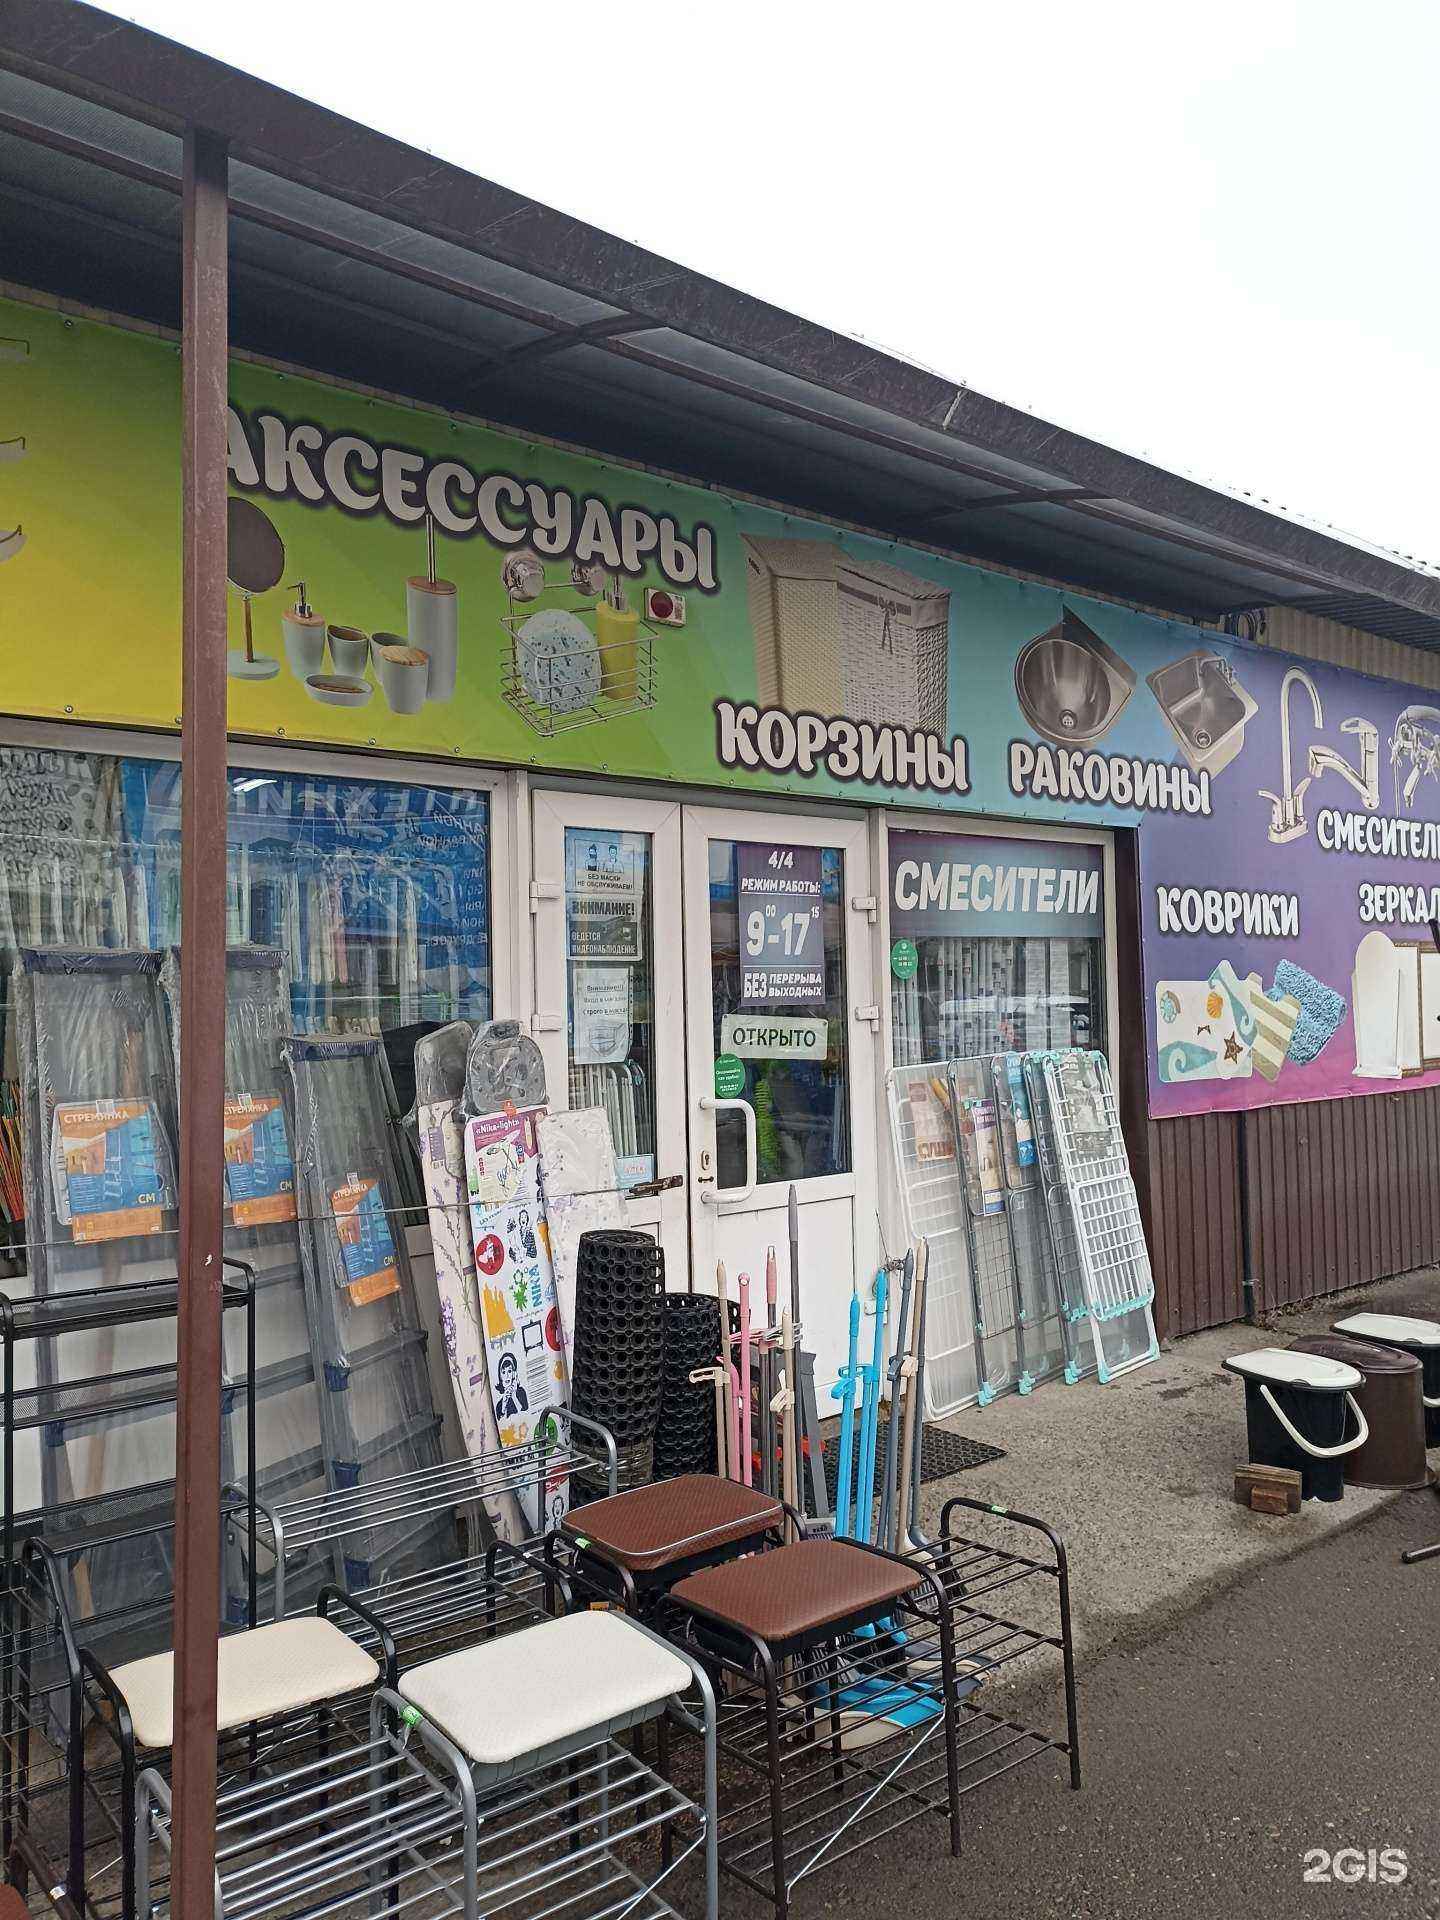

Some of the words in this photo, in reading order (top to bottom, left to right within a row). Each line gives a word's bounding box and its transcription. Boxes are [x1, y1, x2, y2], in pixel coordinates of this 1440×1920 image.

[716, 702, 968, 790] КОРЗИНЫ
[1010, 743, 1211, 814] РАКОВИНЫ
[1317, 809, 1440, 859] СМЕСИТЕЛ
[768, 851, 793, 869] 4/4
[741, 878, 778, 892] РЕЖИМ
[779, 880, 820, 894] РАБОТЫ:
[895, 860, 1099, 914] СМЕСИТЕЛИ
[571, 900, 635, 916] ВНИМАНИЕ!
[1157, 886, 1298, 936] КОВРИКИ
[743, 972, 767, 998] БЕЗ
[769, 973, 821, 984] ПЕРЕРЫВА
[769, 986, 821, 998] ВЫХОДНЫХ
[732, 1027, 816, 1048] ОТКРЫТО
